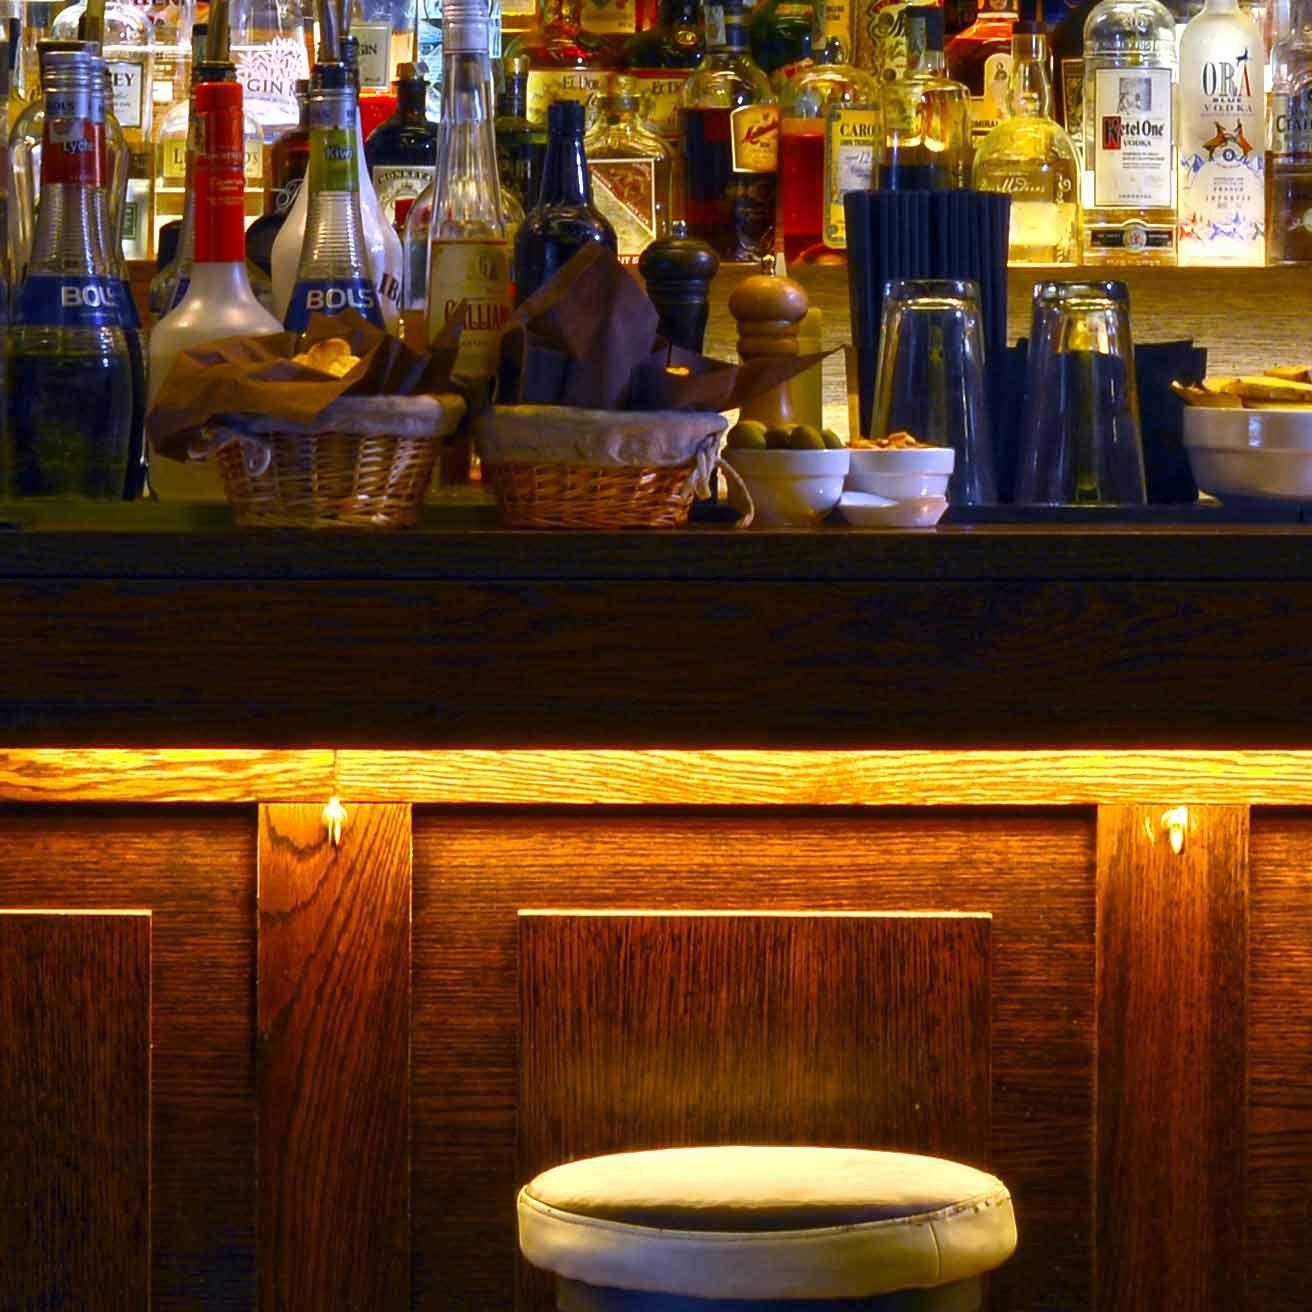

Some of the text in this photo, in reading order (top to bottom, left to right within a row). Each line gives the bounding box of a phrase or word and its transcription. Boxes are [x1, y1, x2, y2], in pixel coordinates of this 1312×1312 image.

[247, 77, 284, 94] GIN
[1202, 61, 1251, 97] ORA
[1203, 104, 1253, 114] VODKA
[839, 122, 873, 137] CARO
[1103, 118, 1165, 149] Ketel One
[1123, 139, 1153, 148] VODKA
[324, 147, 354, 161] Kiwi
[306, 288, 375, 310] BOLS
